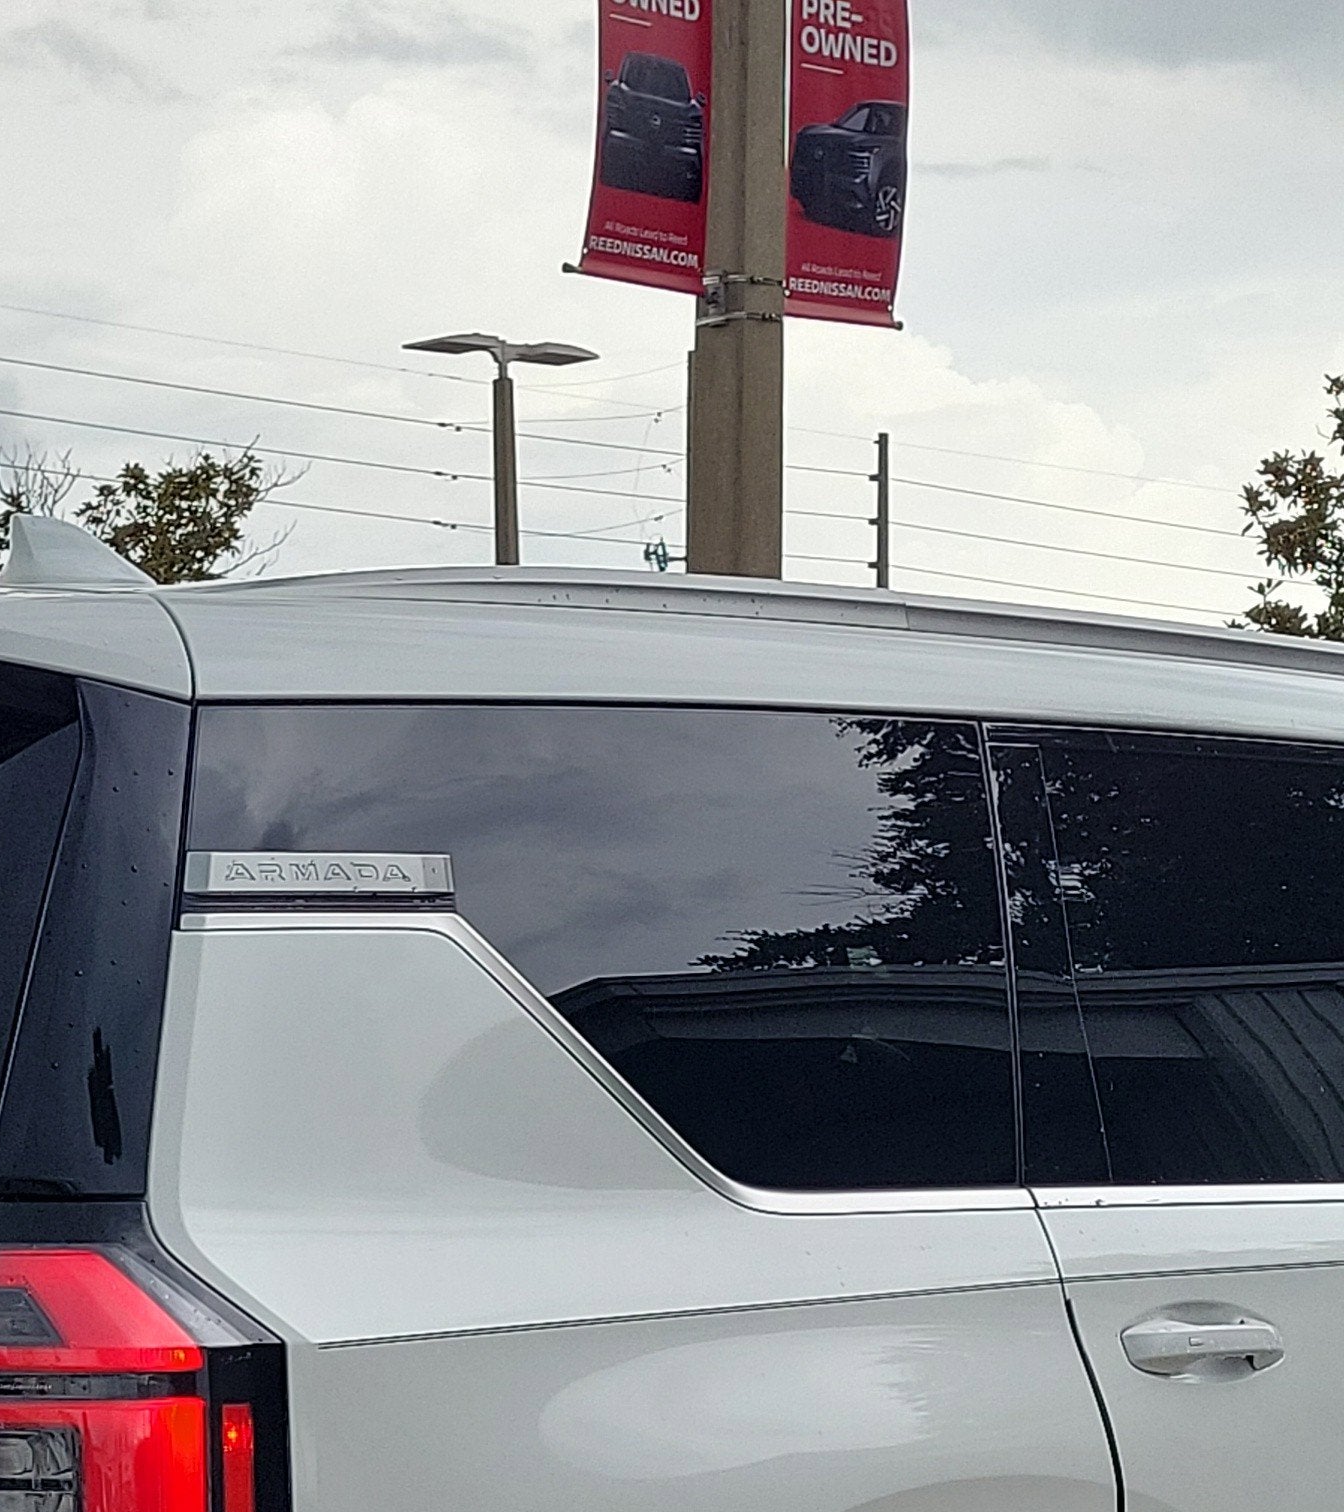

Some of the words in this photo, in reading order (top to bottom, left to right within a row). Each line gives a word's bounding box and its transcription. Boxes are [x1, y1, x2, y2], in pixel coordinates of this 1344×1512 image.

[613, 0, 700, 21] NED
[802, 0, 864, 28] PRE-
[800, 25, 898, 67] OWNED
[589, 235, 698, 267] REEDNISSAN.COM
[789, 276, 891, 301] REEDNISSAN.COM
[225, 862, 412, 883] ARMADA
